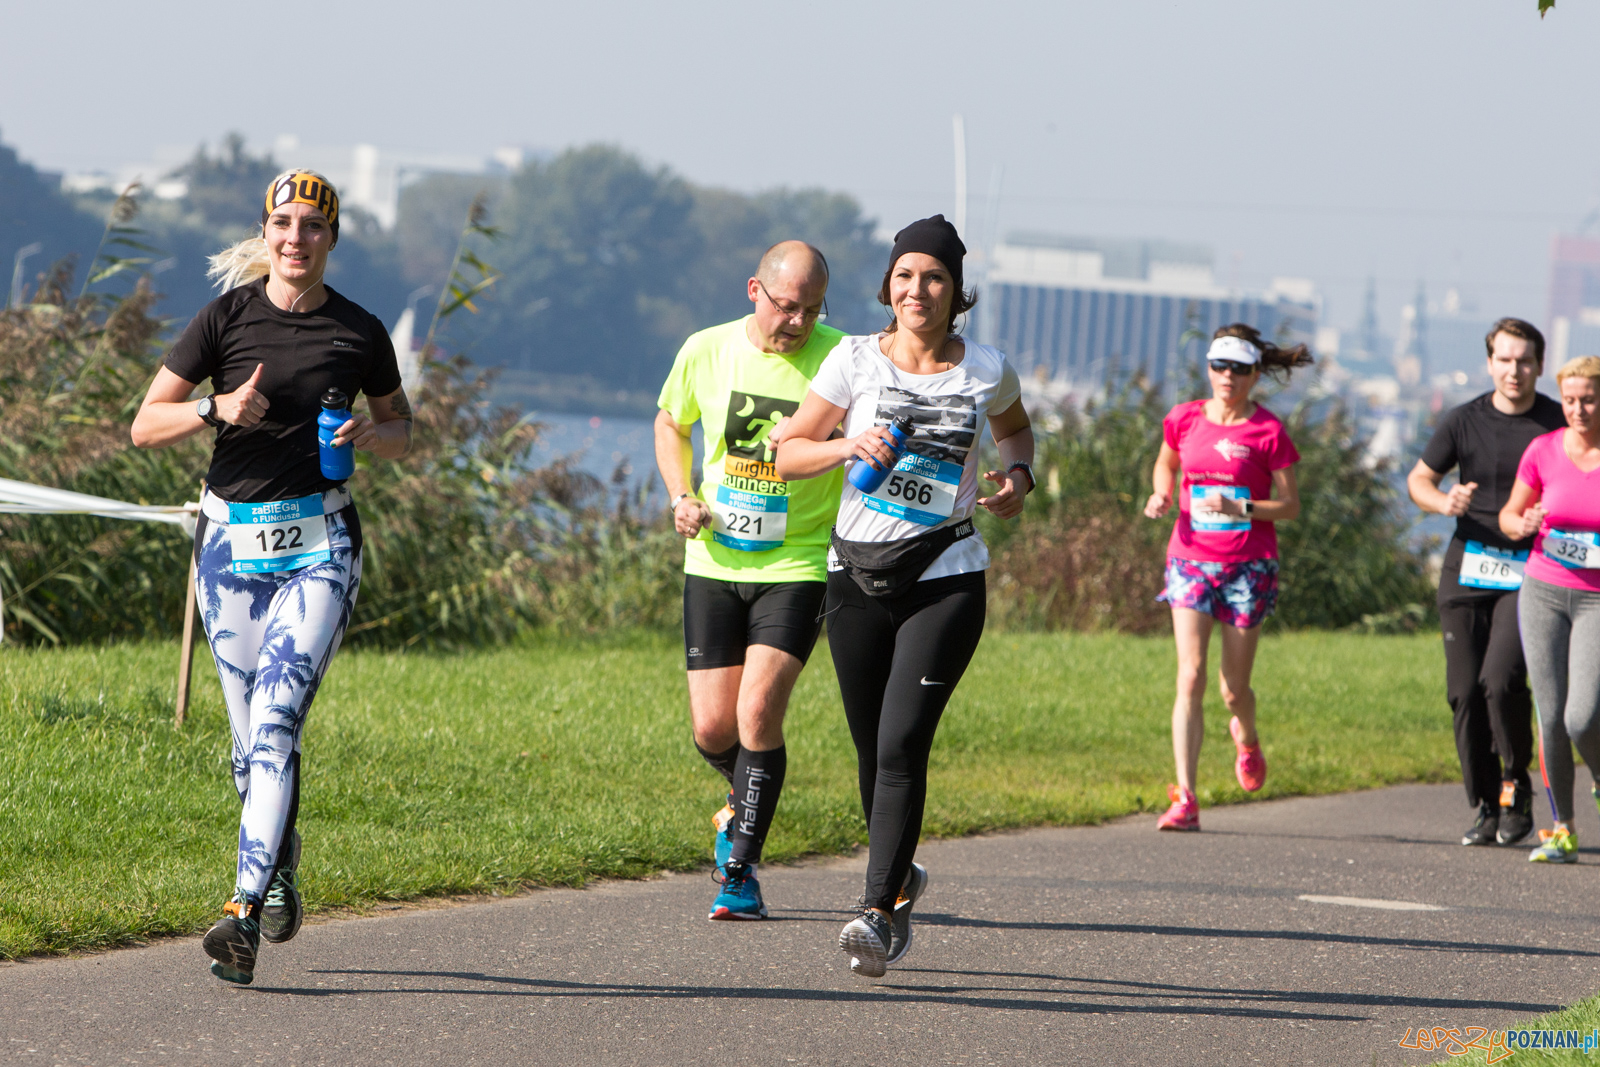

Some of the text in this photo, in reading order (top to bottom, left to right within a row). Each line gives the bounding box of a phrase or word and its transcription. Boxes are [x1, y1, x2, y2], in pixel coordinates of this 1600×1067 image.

[735, 459, 776, 477] night
[900, 462, 938, 479] FUNdusze
[729, 491, 768, 506] zaBIEGaj
[887, 474, 934, 506] 566
[251, 501, 300, 515] zaBIEGaj
[733, 500, 767, 512] FUNdusze
[260, 513, 301, 523] FUNdusze
[726, 512, 763, 535] 221
[255, 525, 304, 552] 122
[1557, 541, 1588, 562] 323
[1479, 560, 1511, 577] 676
